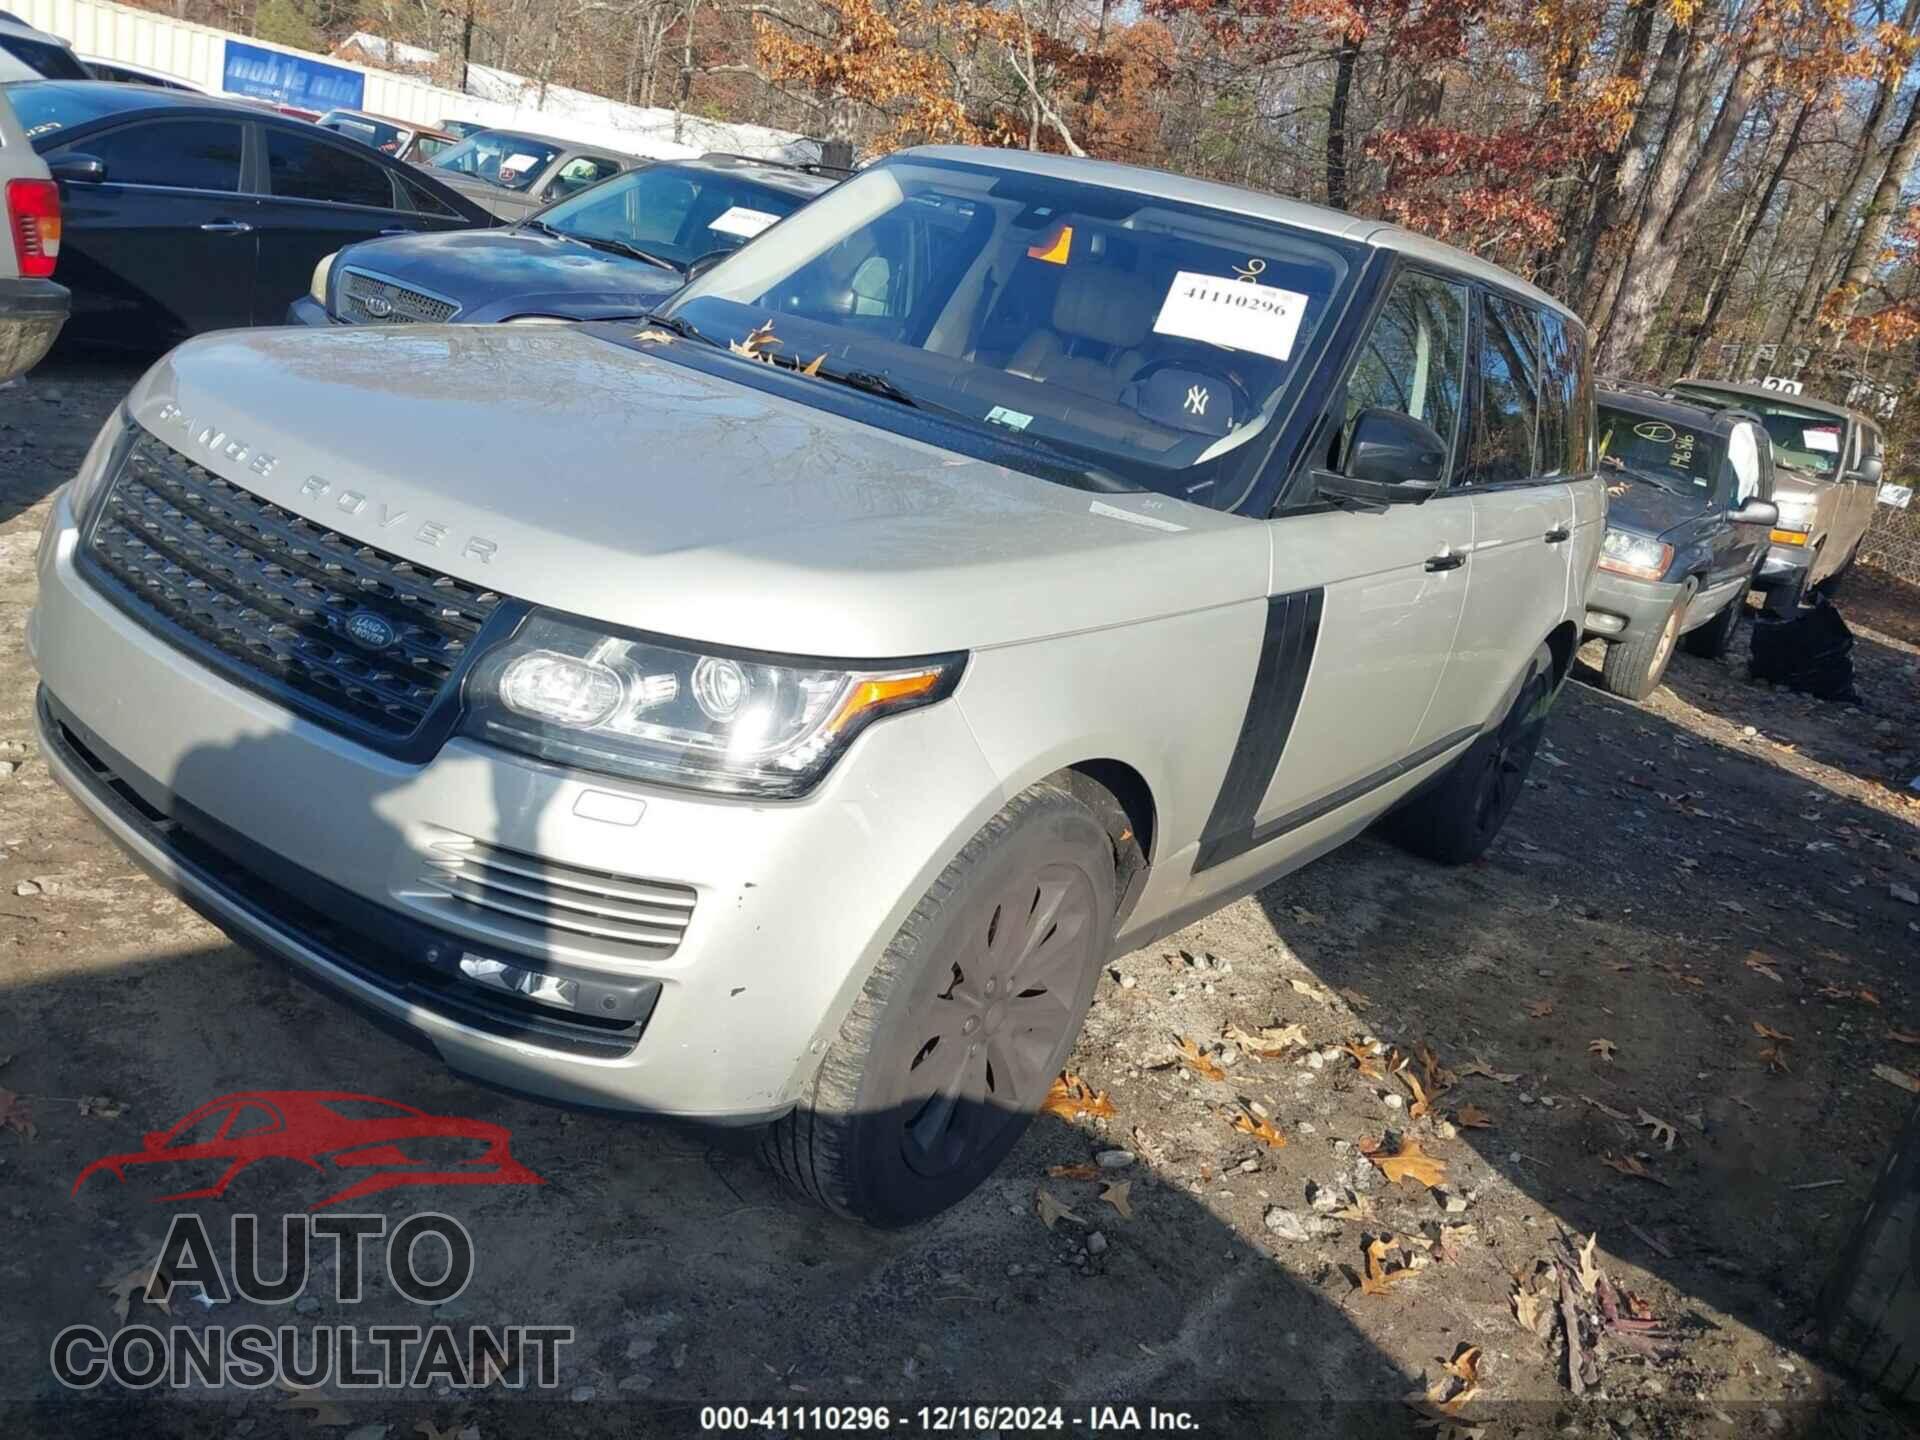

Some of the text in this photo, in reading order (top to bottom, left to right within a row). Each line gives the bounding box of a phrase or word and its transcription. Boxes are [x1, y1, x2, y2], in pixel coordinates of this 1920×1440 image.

[1184, 287, 1286, 316] 41110296
[160, 404, 499, 565] RANGE ROVER
